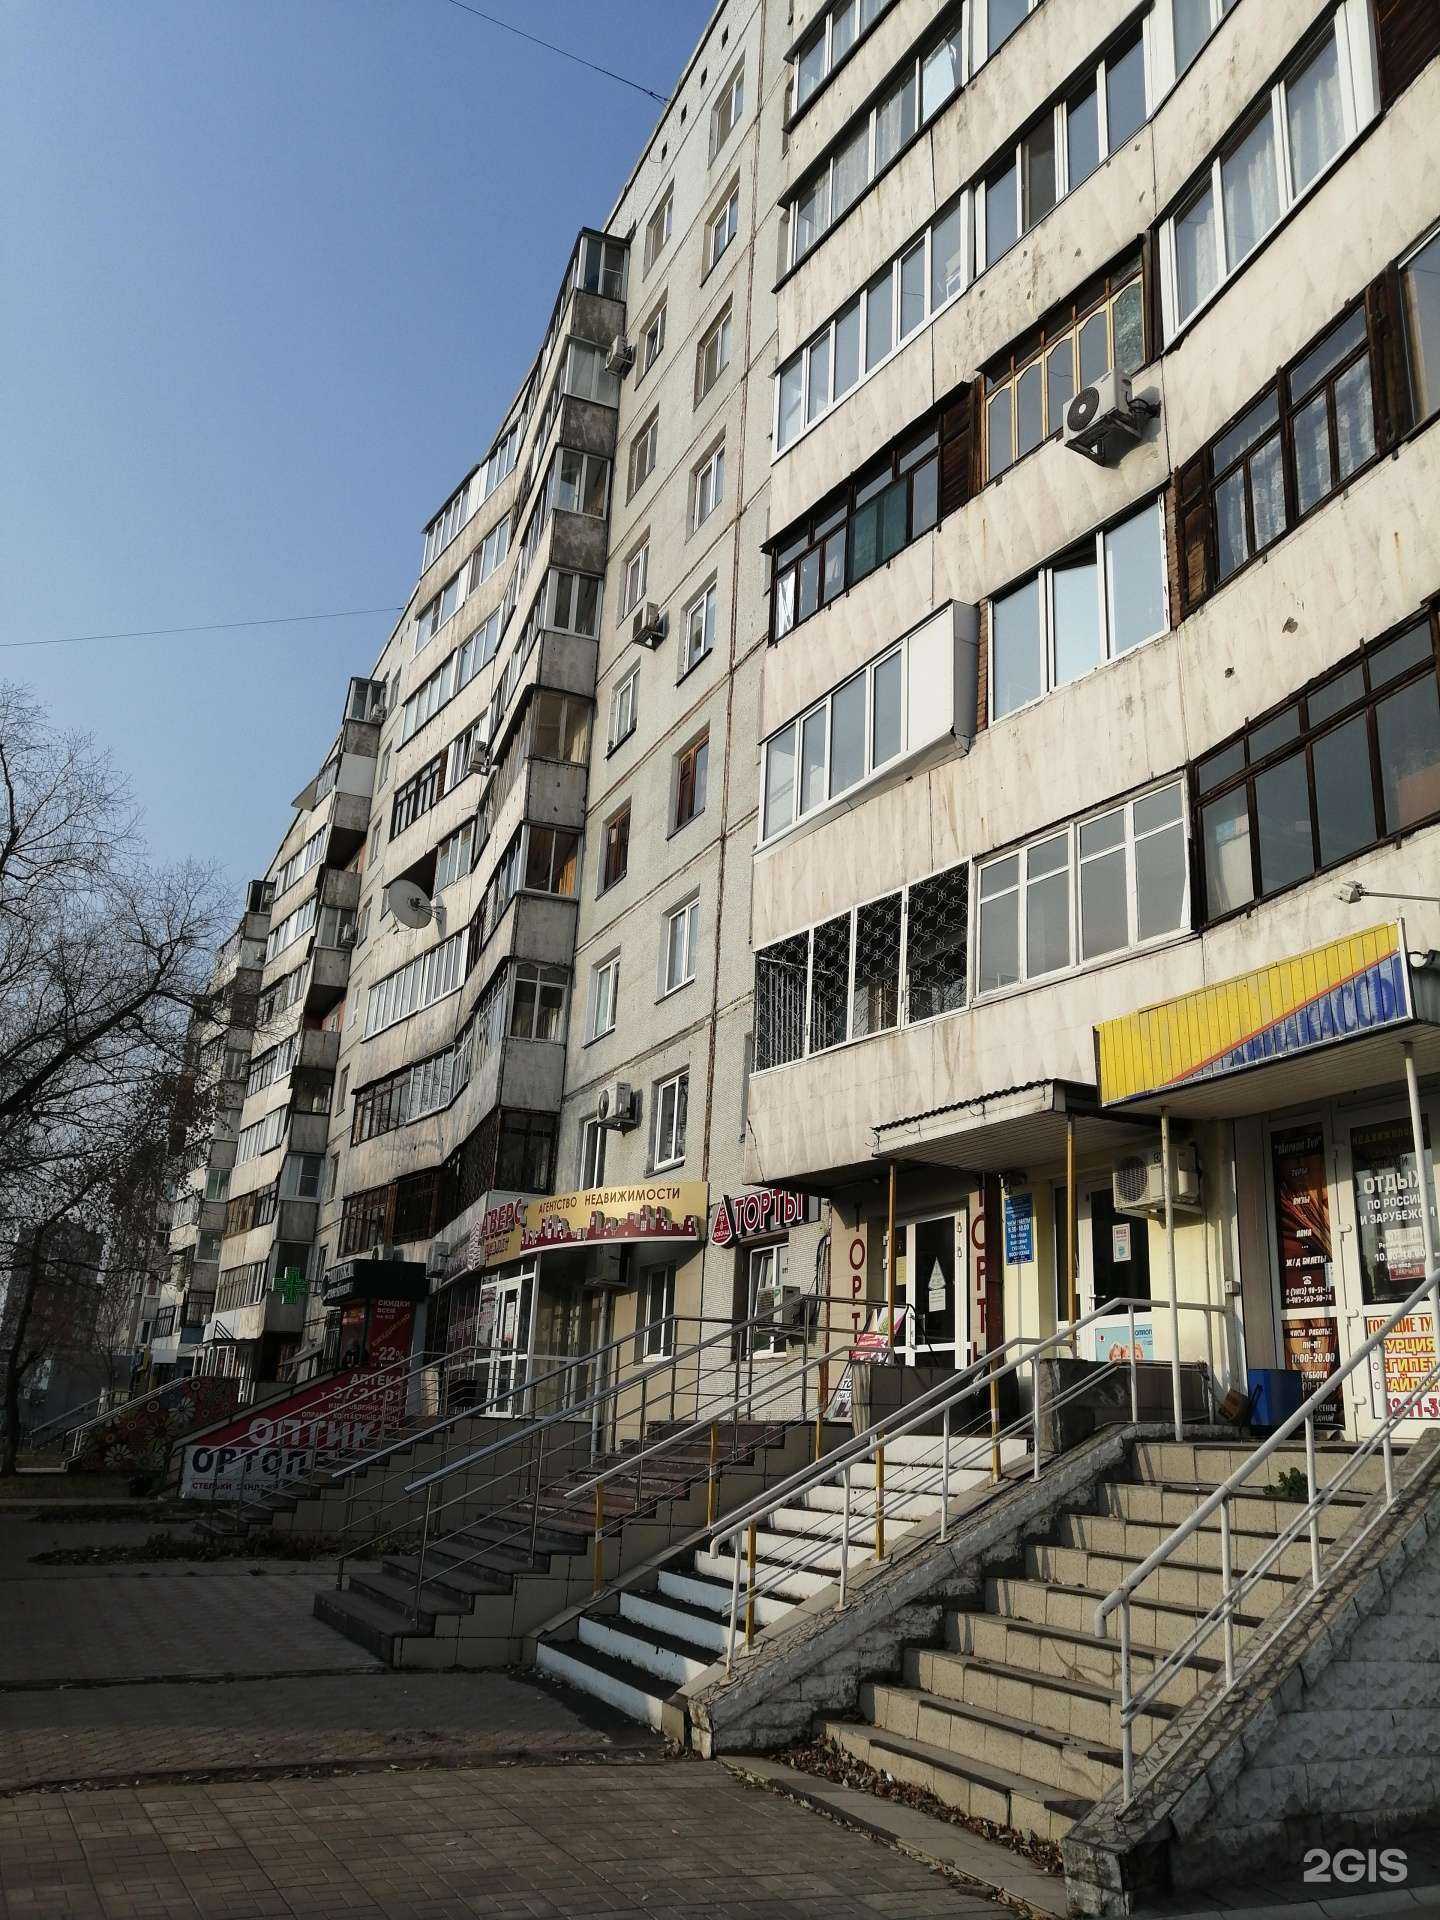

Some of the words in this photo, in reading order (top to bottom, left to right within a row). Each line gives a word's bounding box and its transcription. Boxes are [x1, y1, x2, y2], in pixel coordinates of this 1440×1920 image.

[584, 1187, 681, 1206] НЕДВИЖИМОСТИ
[1367, 1200, 1381, 1211] ПО
[735, 1188, 804, 1235] ТОРТЫ
